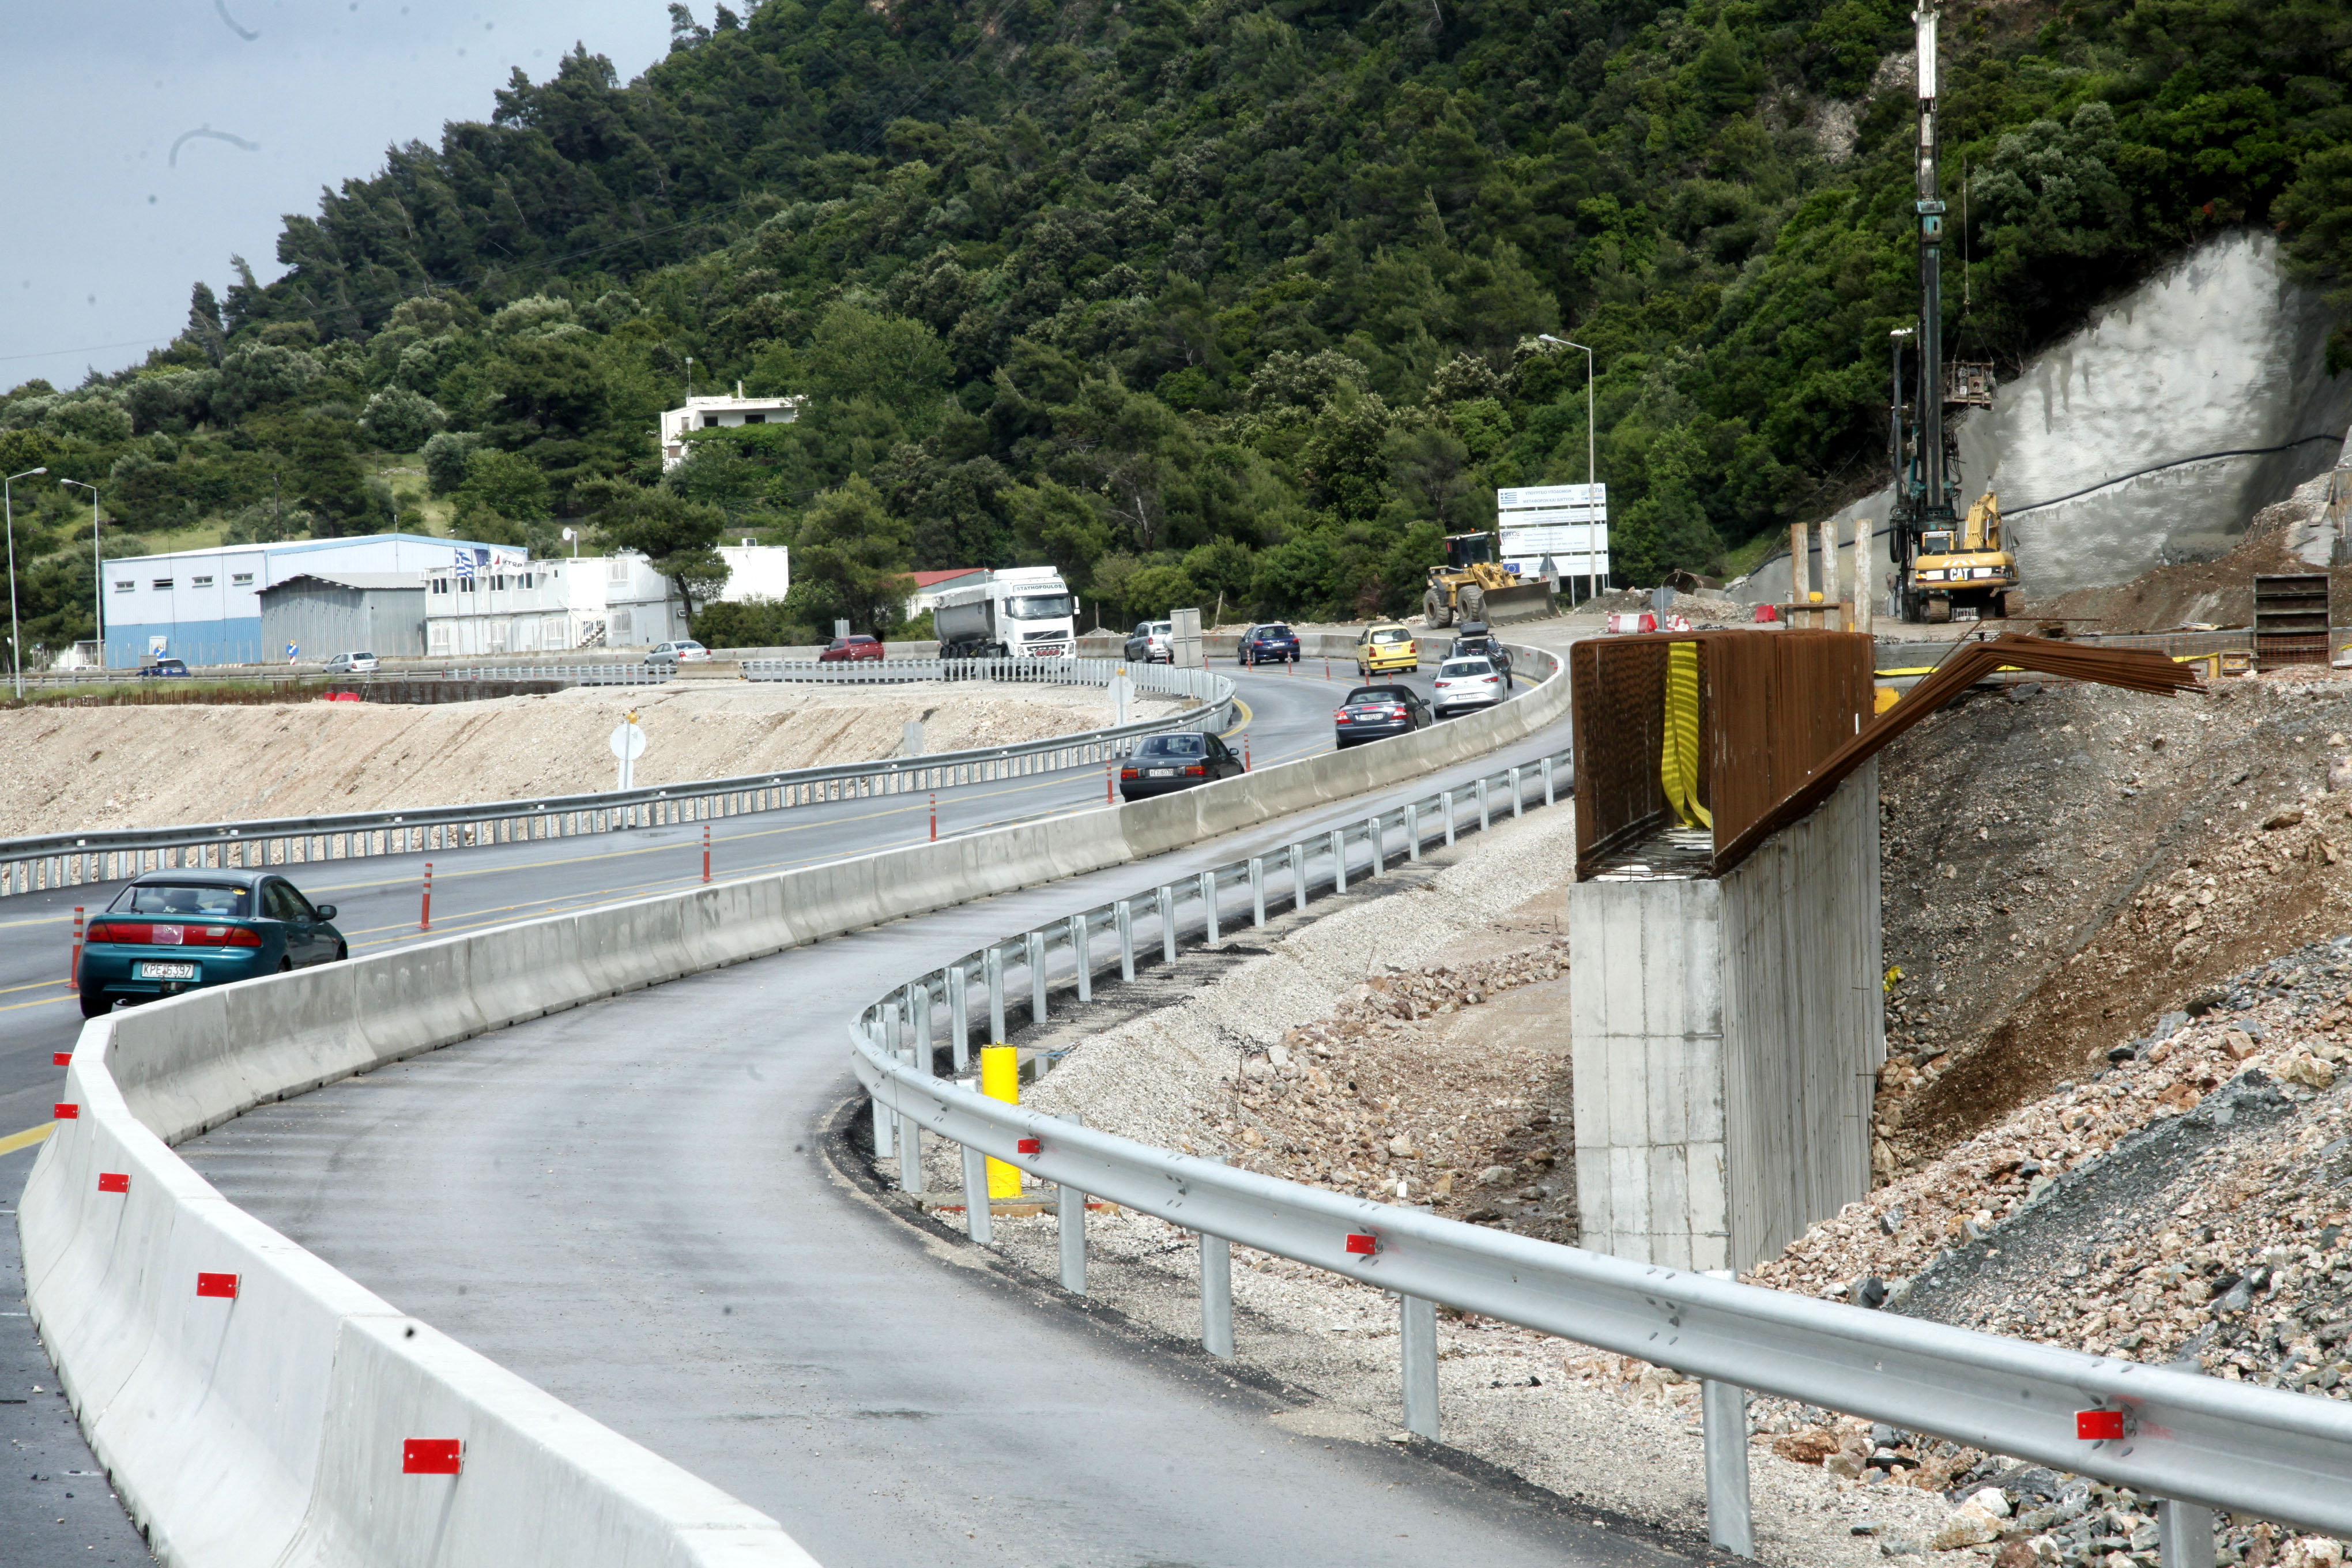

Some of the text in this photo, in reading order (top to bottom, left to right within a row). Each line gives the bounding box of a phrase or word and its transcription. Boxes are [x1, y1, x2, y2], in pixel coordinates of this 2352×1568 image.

[1950, 568, 1969, 581] CAT
[144, 963, 191, 975] KPE 6397
